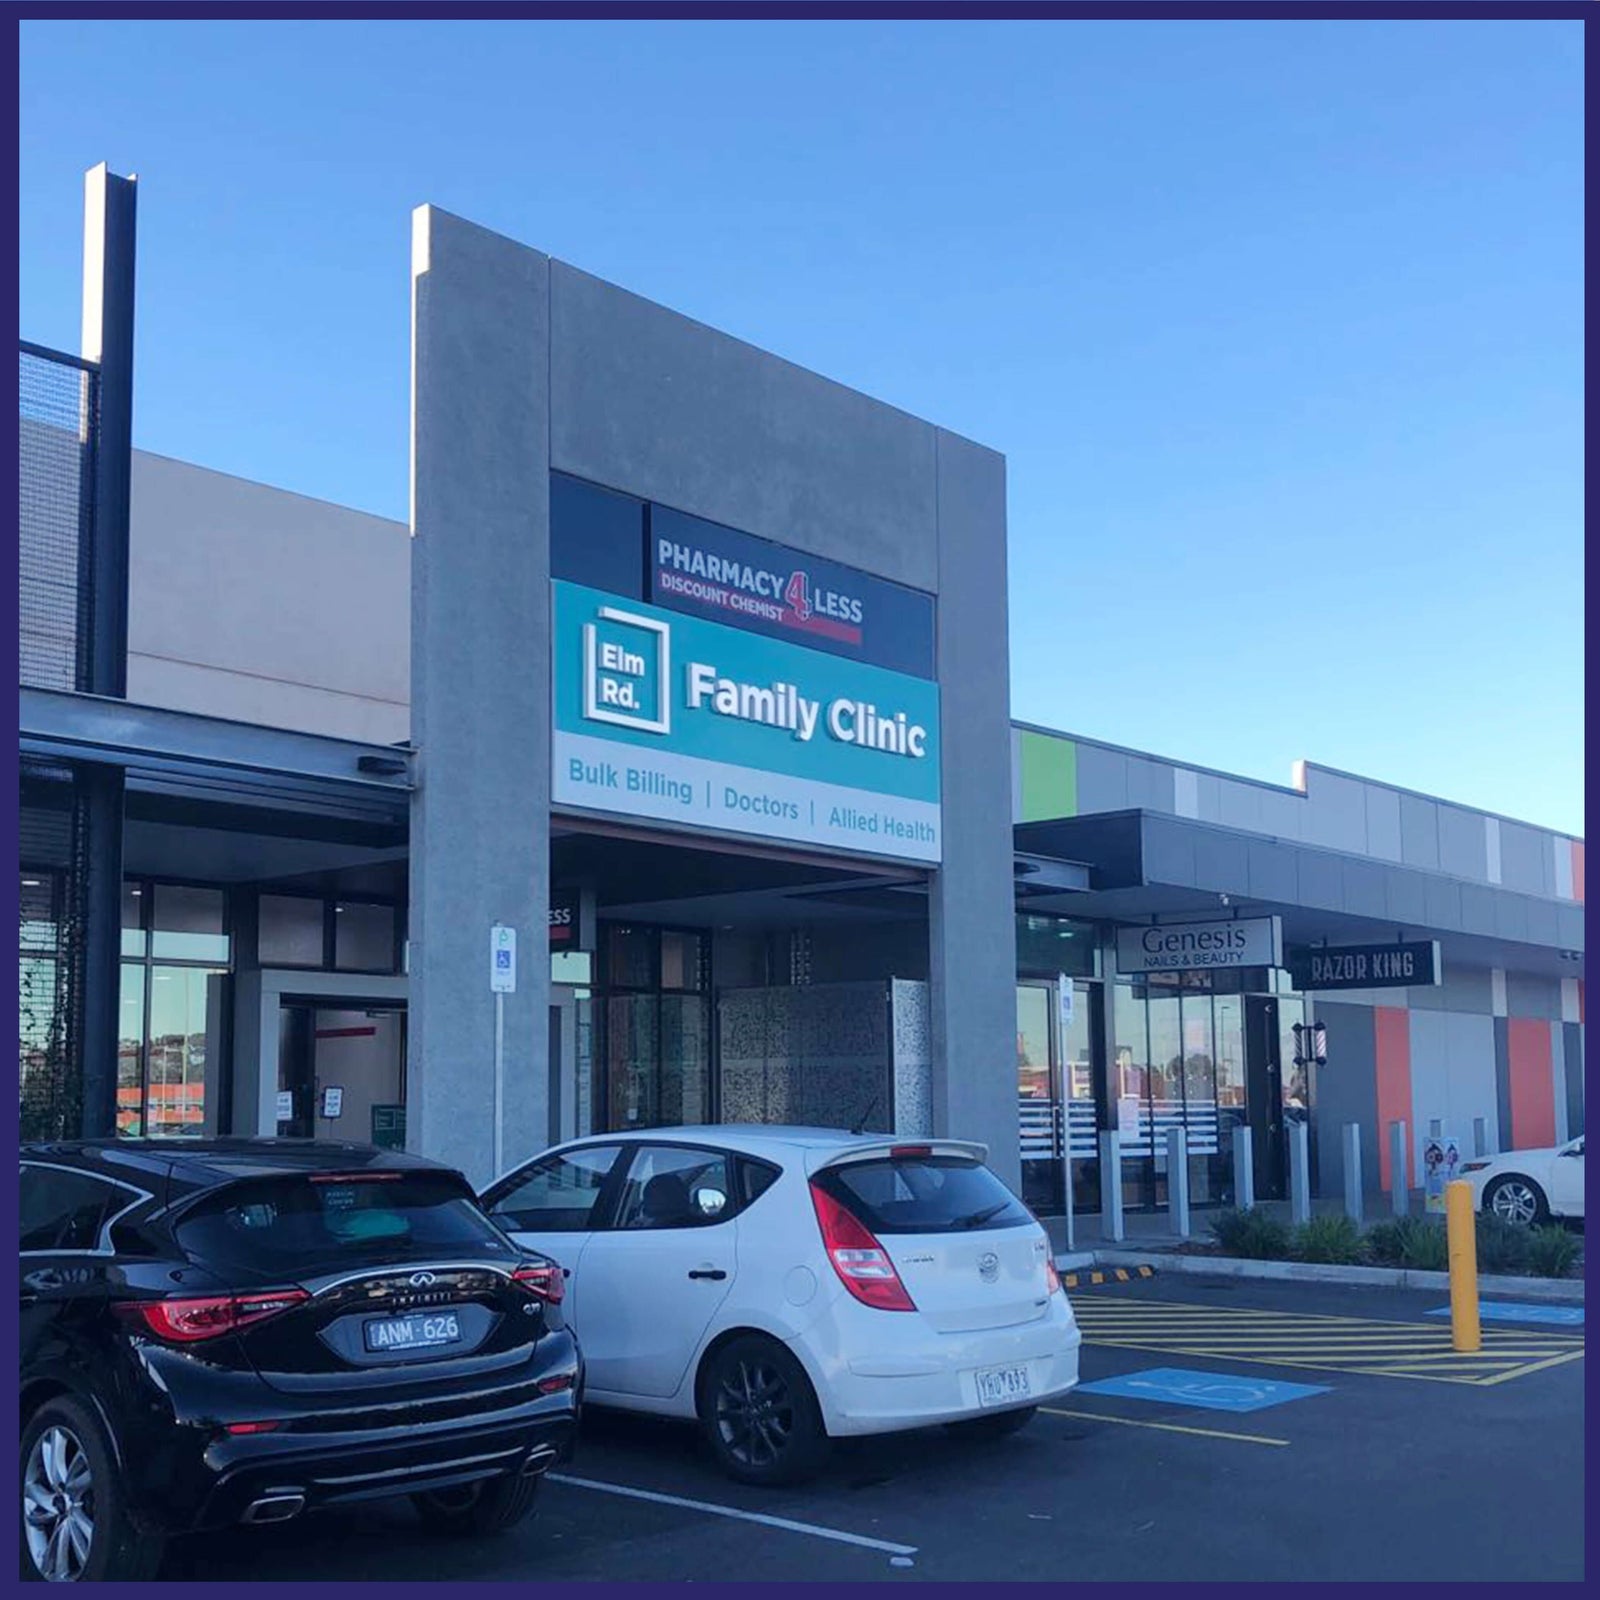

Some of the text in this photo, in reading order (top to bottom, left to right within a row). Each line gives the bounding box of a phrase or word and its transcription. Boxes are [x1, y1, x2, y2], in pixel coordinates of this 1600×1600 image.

[658, 539, 863, 623] PHARMACY 4 LESS
[661, 573, 784, 621] DISCOUNT CHEMIST
[600, 643, 645, 676] Elm
[600, 678, 640, 709] Rd.
[686, 662, 926, 757] Family Clinic
[569, 758, 936, 843] Bulk Billing Doctors Allied Health
[1142, 924, 1247, 953] Genesis
[1144, 951, 1244, 968] NAILS & BEAUTY
[1312, 952, 1414, 983] RAZOR KING
